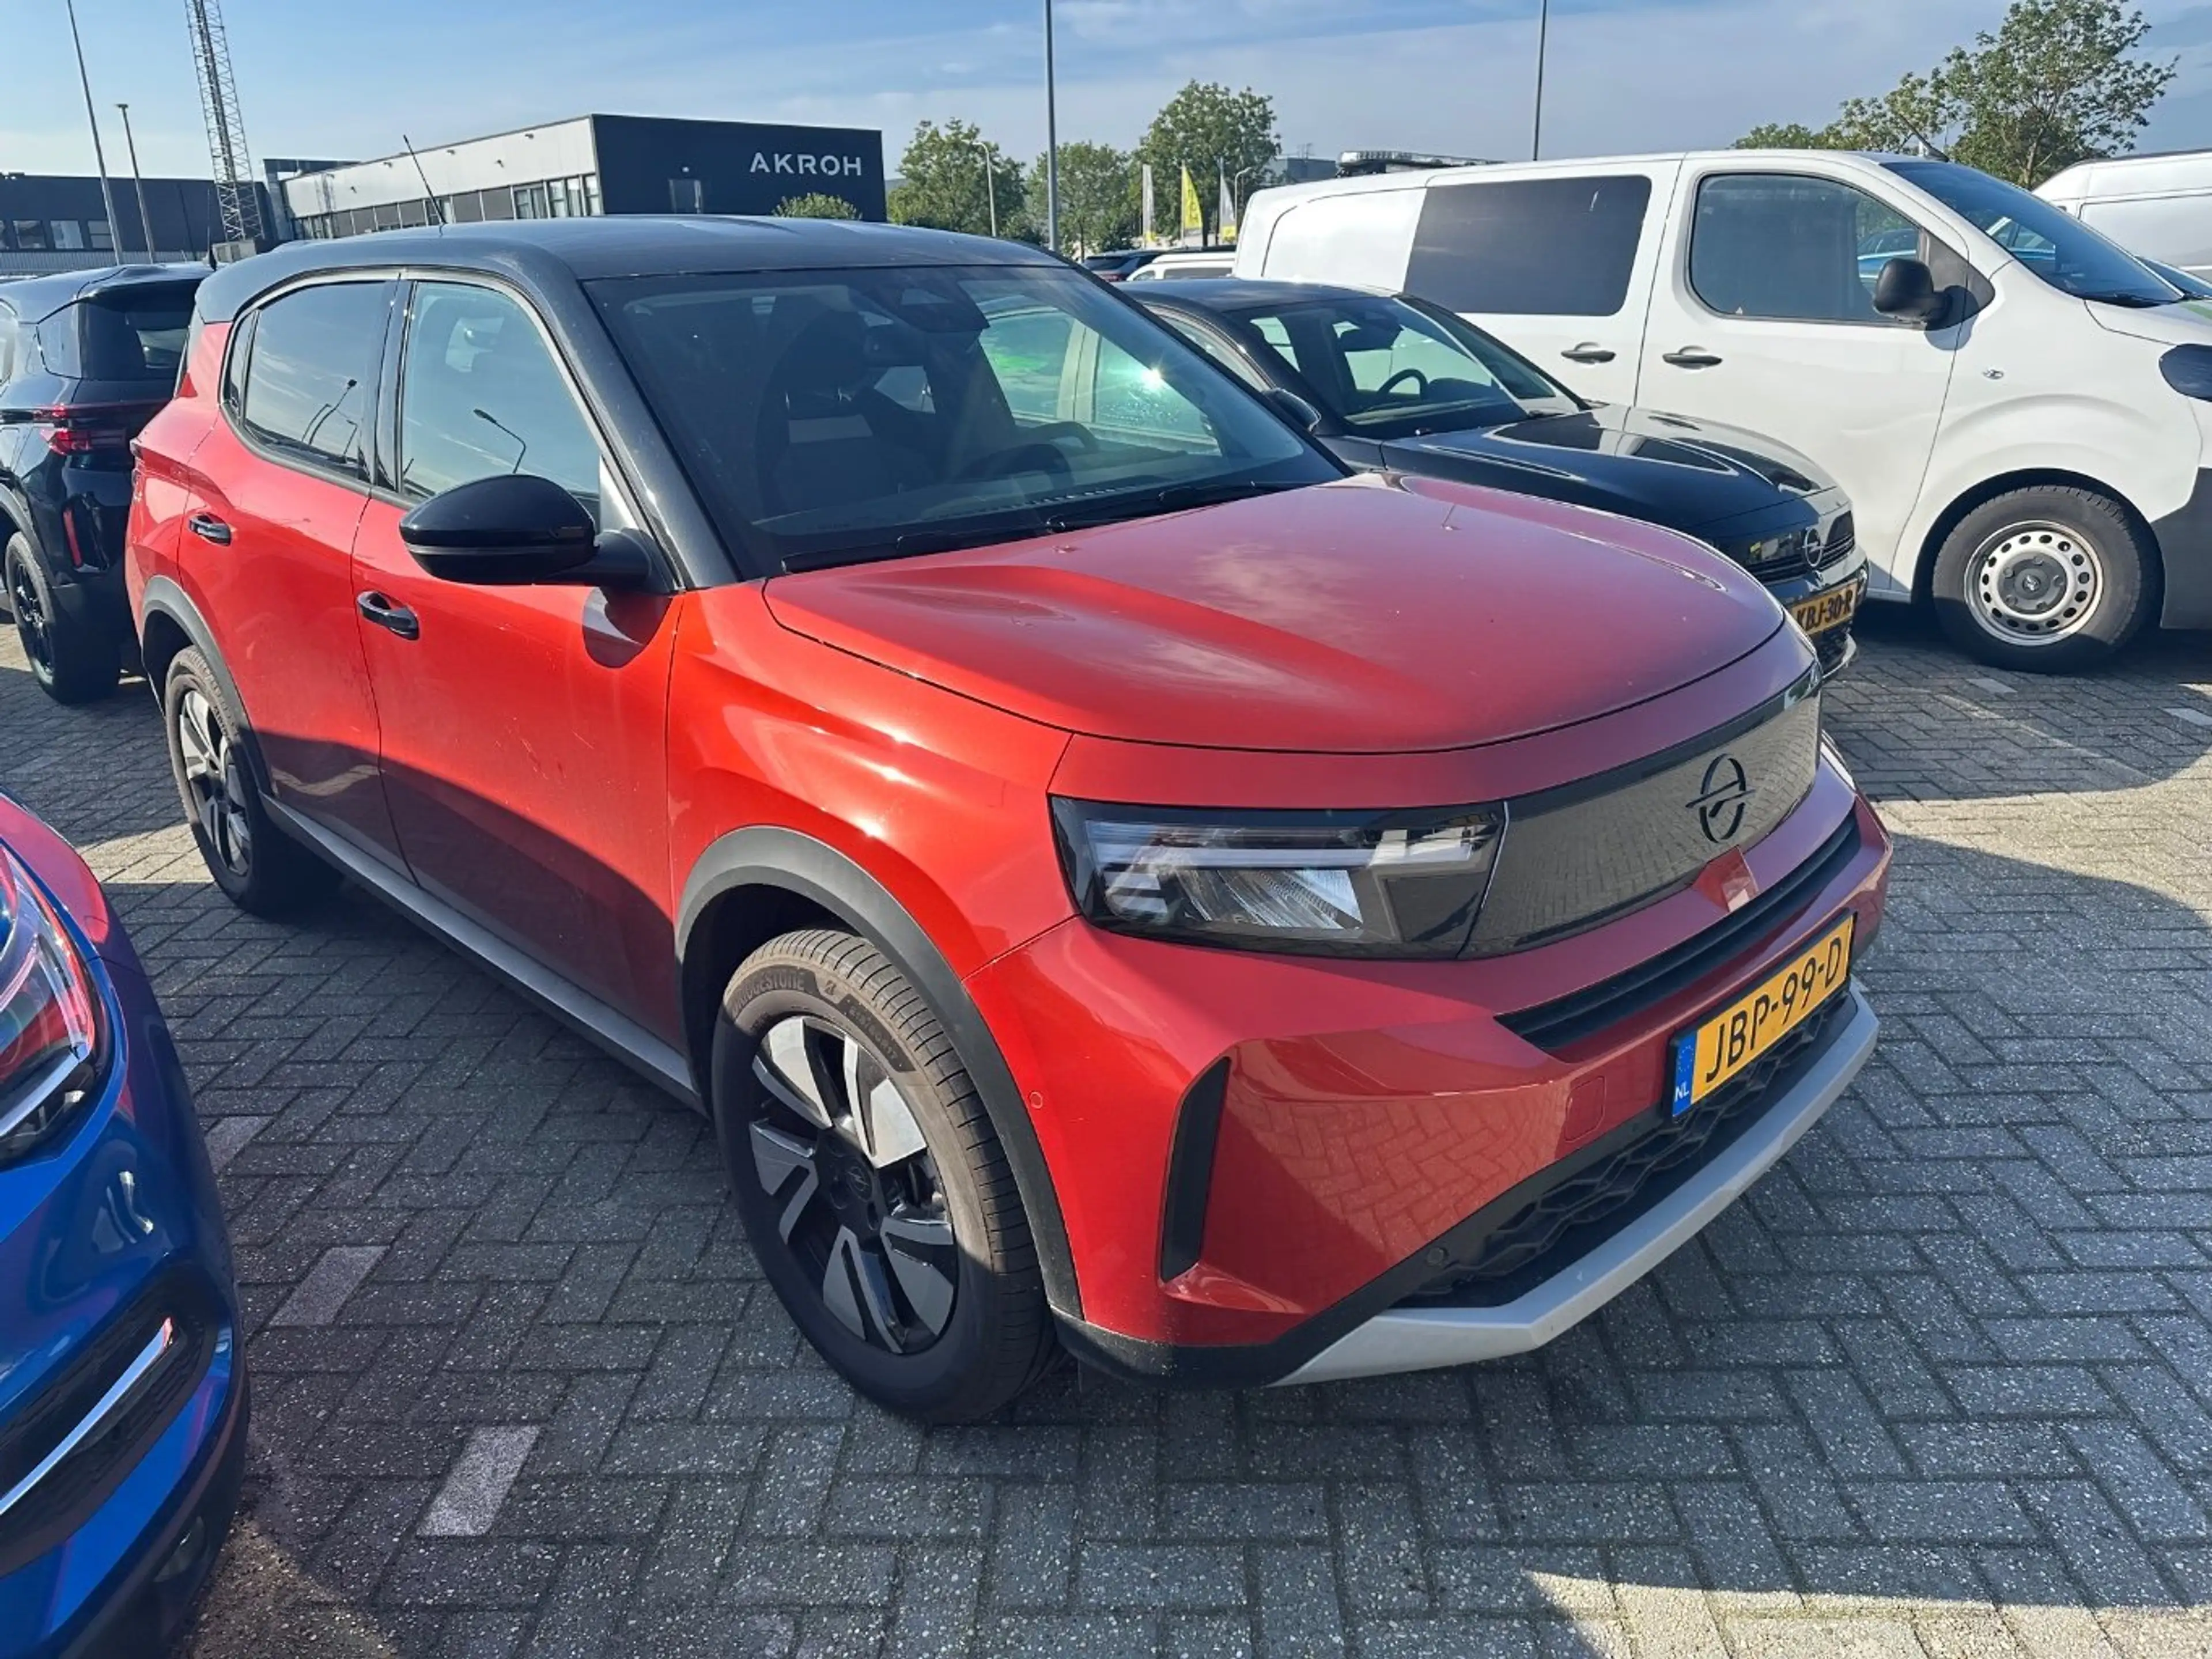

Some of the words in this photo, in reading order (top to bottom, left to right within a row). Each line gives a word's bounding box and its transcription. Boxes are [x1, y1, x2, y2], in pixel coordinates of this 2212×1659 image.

[750, 151, 861, 176] AKROH
[1706, 937, 1842, 1083] JBP-99-D
[1674, 1080, 1689, 1102] NL
